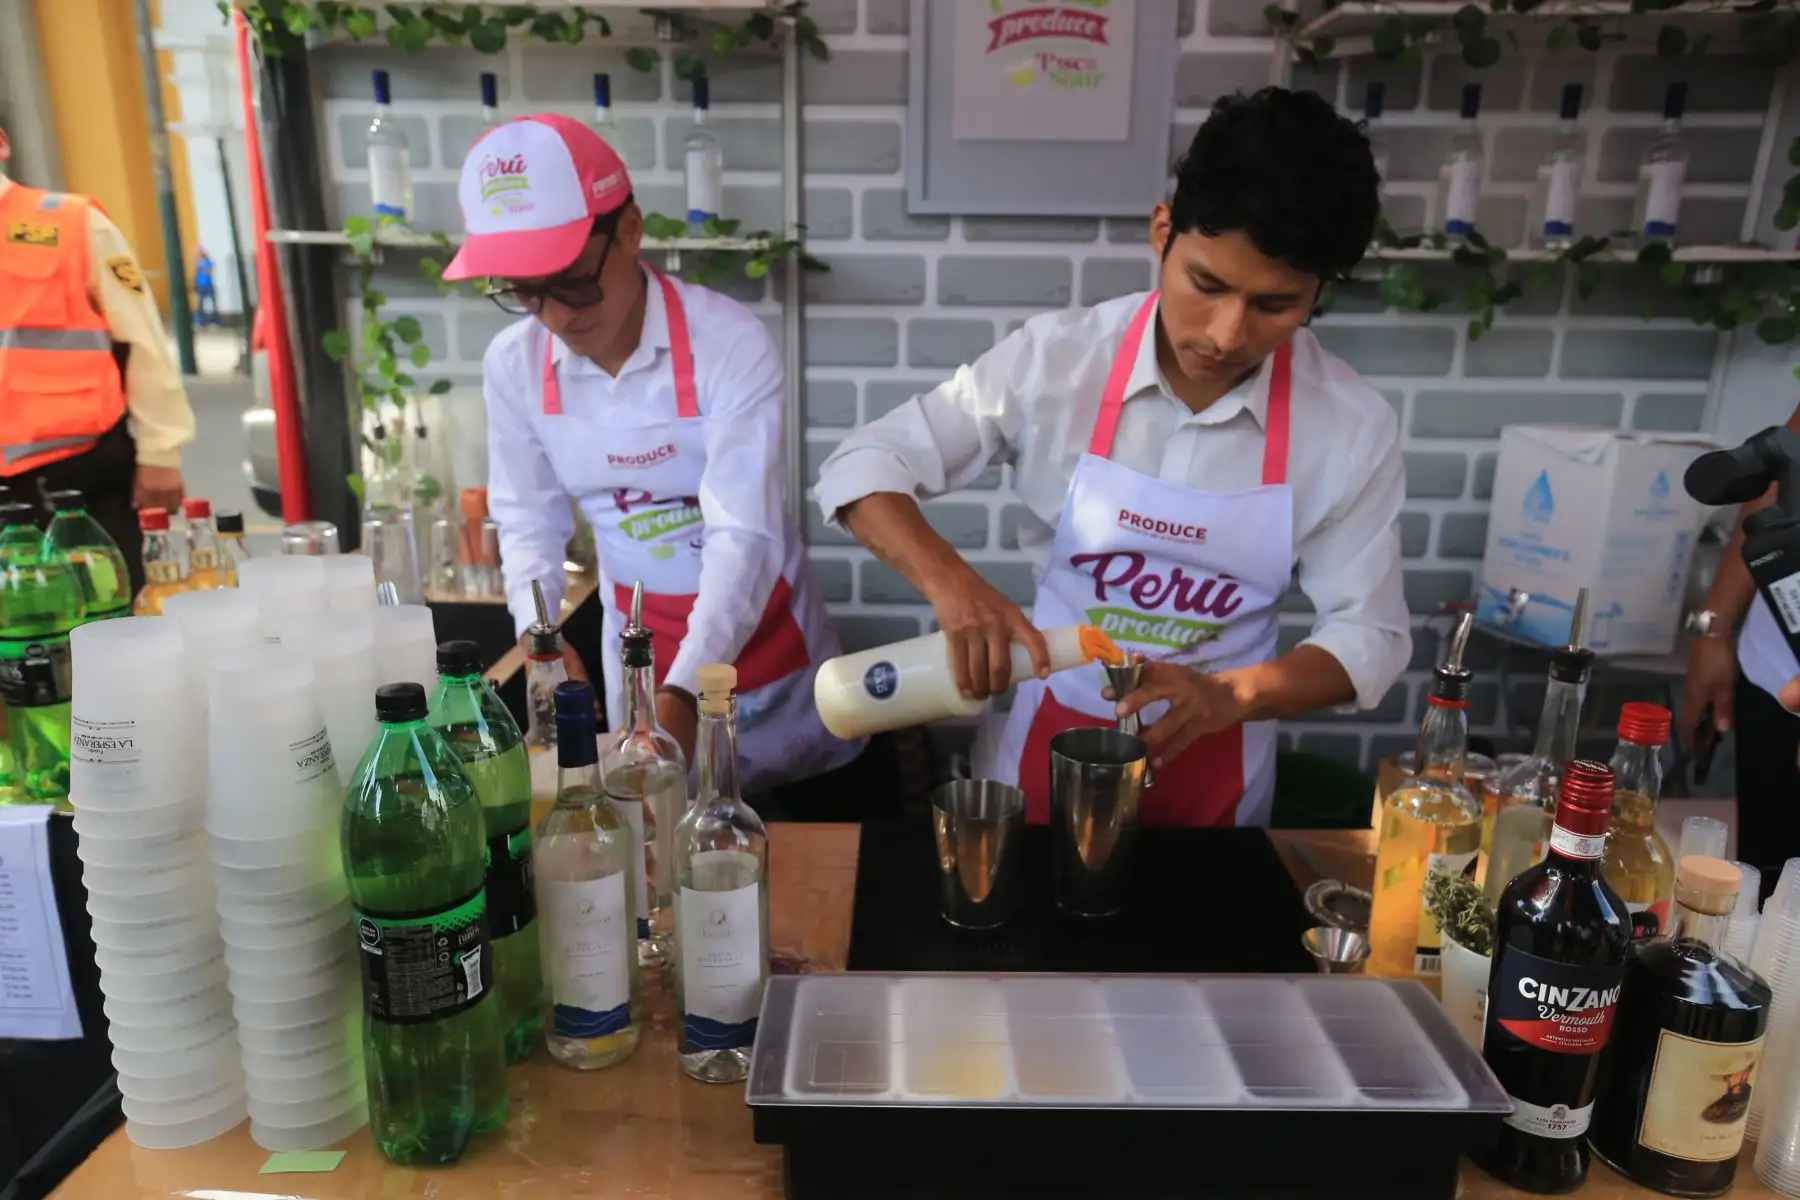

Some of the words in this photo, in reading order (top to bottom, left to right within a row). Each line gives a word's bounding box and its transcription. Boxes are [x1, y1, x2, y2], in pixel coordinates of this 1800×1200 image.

[1002, 10, 1097, 44] produce
[607, 443, 676, 465] PRODUCE
[1118, 509, 1208, 540] PRODUCE
[1070, 551, 1245, 618] Perú
[118, 740, 133, 748] LA
[1518, 976, 1621, 1012] CINZANO
[1537, 1004, 1606, 1026] Vermouth
[1559, 1024, 1588, 1033] ROSSO
[1547, 1123, 1567, 1131] 1757
